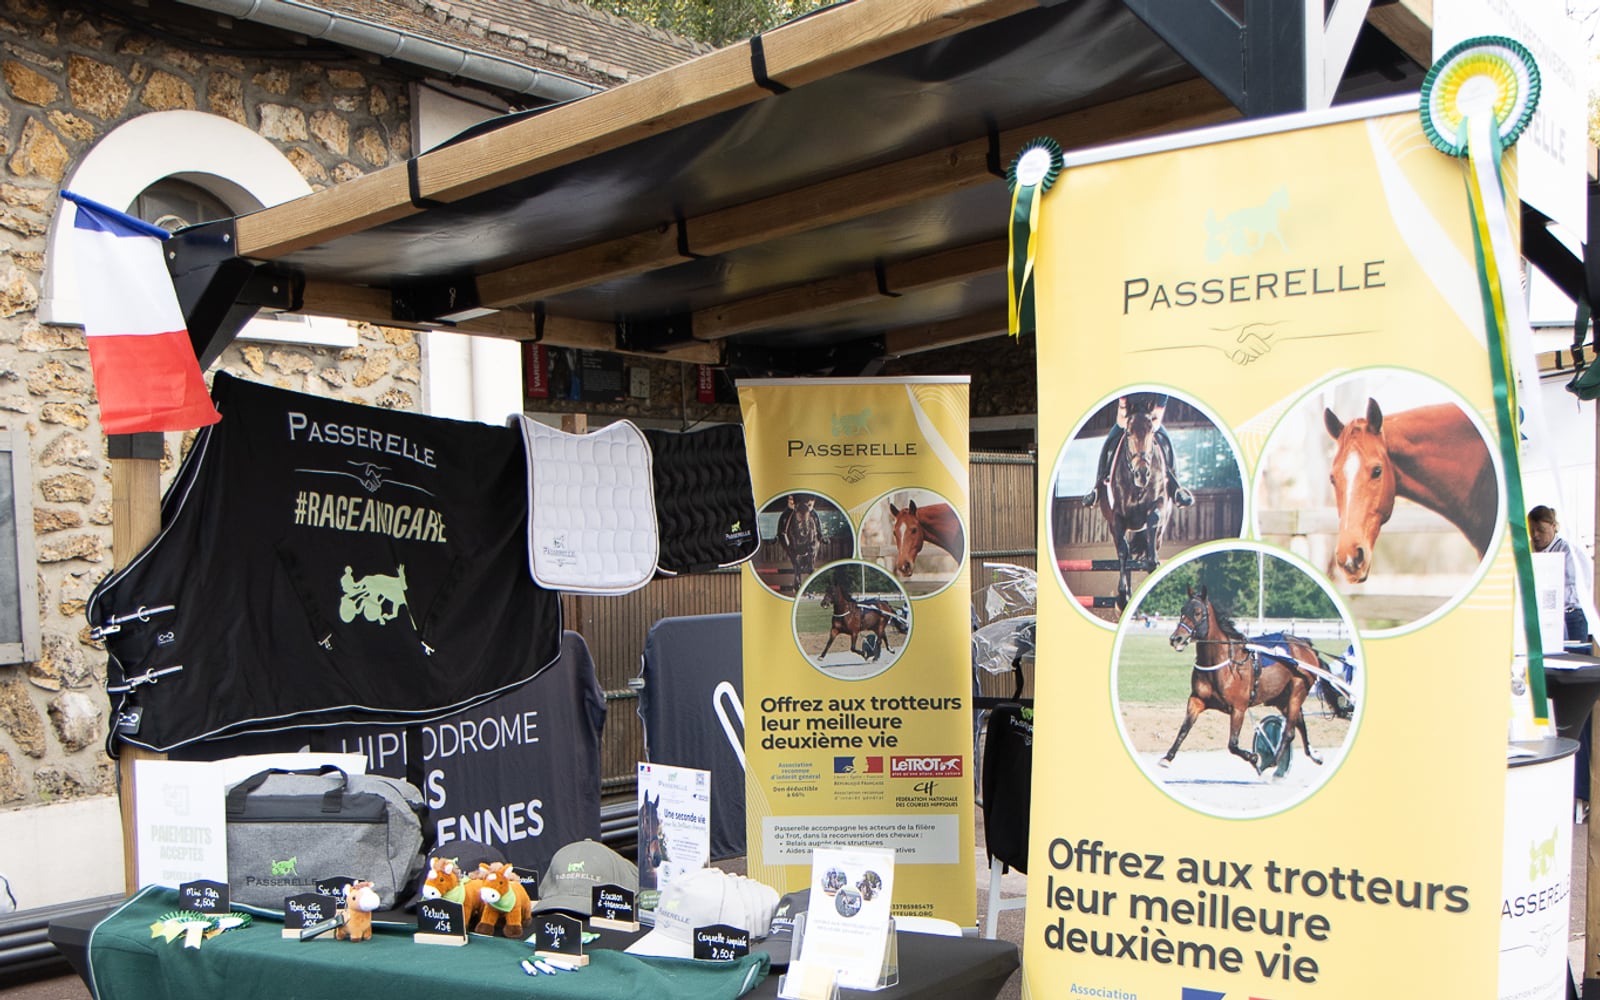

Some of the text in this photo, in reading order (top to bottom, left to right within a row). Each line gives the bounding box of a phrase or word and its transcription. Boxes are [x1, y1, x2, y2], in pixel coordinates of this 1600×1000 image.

[1123, 259, 1386, 315] PASSERELLE
[288, 412, 437, 469] PASSERELLE
[787, 440, 917, 457] PASSERELLE
[294, 490, 447, 543] #RACEANDCARE
[760, 695, 962, 713] Offrez aux trotteurs
[761, 713, 903, 731] leur meilleure
[342, 711, 539, 770] HIPODROME
[761, 731, 898, 750] deuxième vie
[891, 757, 941, 772] LeTROT
[437, 799, 544, 847] ENNES
[674, 810, 697, 823] seconde
[786, 832, 802, 840] Trot,
[811, 825, 857, 833] accompagne
[915, 823, 936, 831] filière
[1048, 837, 1470, 914] Offrez aux trotteurs
[1500, 874, 1570, 920] ASSERELLE
[422, 905, 450, 920] Peluche
[1046, 875, 1331, 942] leur meilleure
[435, 920, 452, 932] 15€
[544, 922, 565, 938] Stylo
[1044, 917, 1319, 984] deuxième vie
[1070, 981, 1137, 1000] Association
